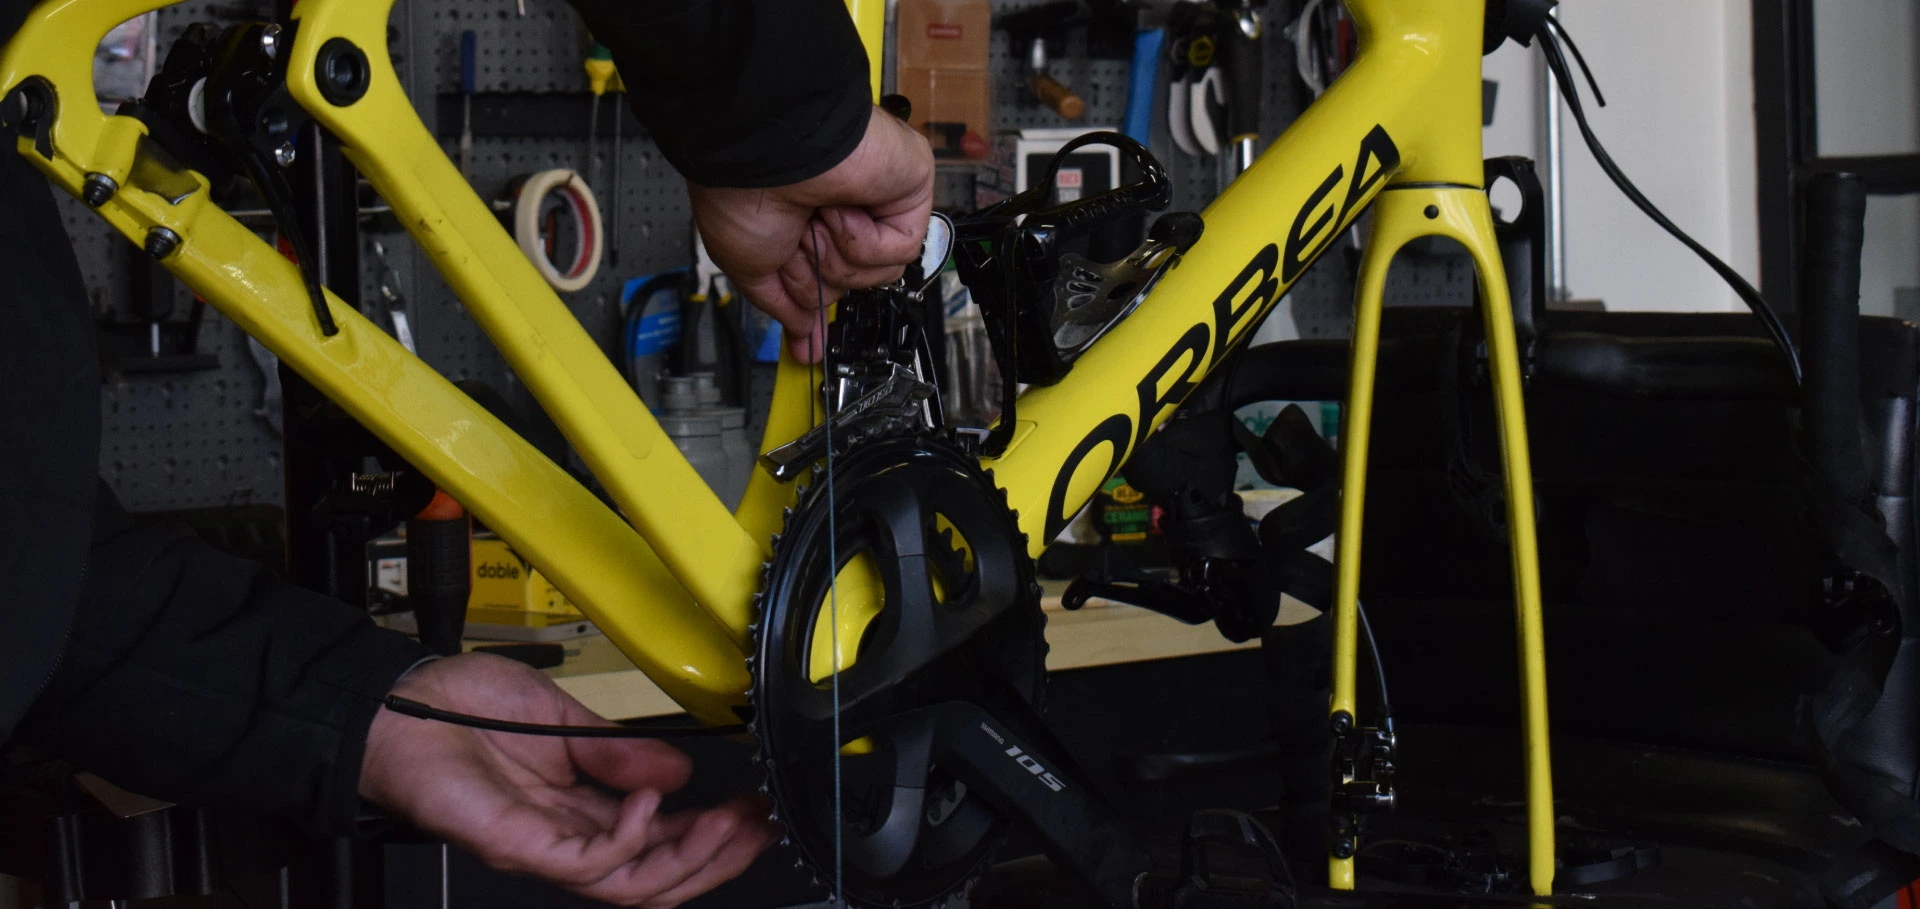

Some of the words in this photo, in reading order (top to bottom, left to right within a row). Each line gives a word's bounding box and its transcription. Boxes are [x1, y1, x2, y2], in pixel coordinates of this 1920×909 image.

[1044, 124, 1400, 546] ORBEA
[477, 561, 519, 579] doble
[1005, 744, 1066, 792] 105
